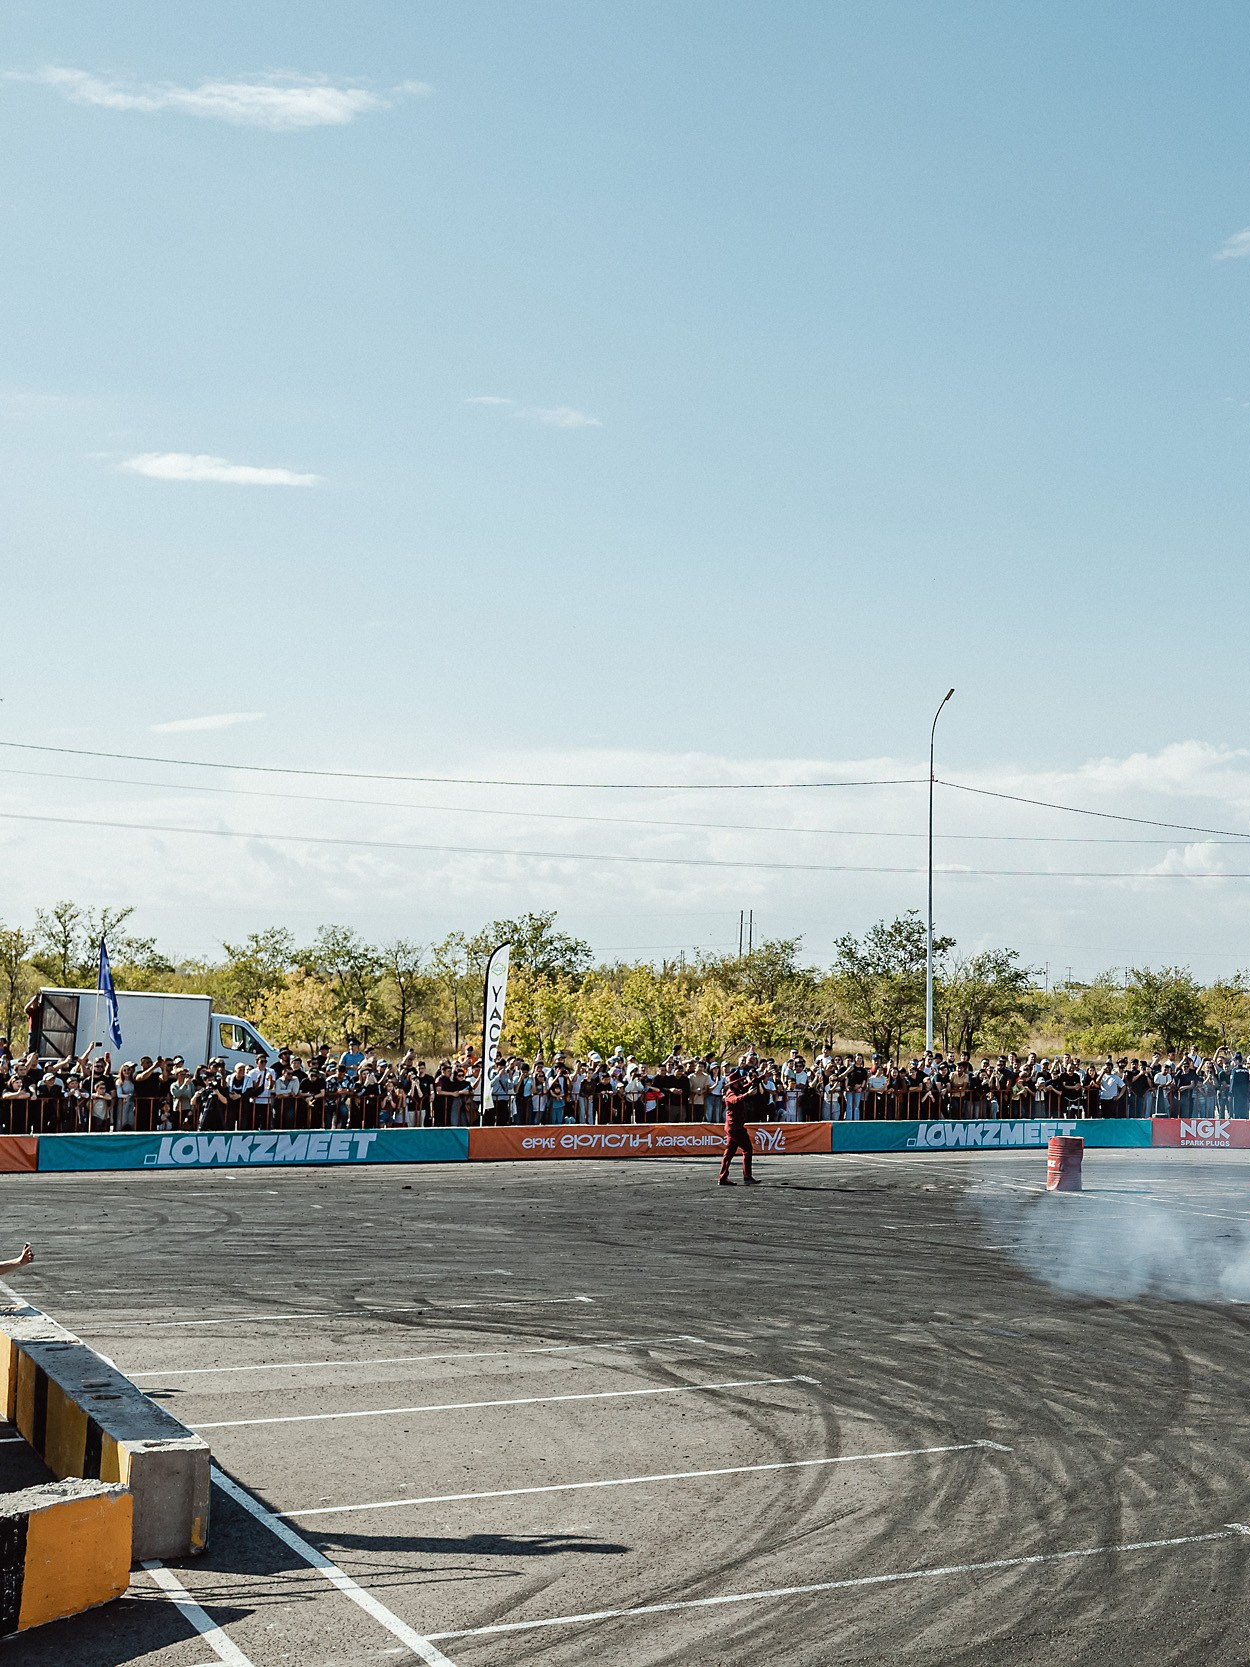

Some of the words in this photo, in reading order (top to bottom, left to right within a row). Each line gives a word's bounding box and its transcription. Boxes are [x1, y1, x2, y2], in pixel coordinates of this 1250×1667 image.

[1180, 1119, 1230, 1140] NGK
[1180, 1139, 1205, 1147] SPARK
[1206, 1139, 1230, 1147] PLUGS
